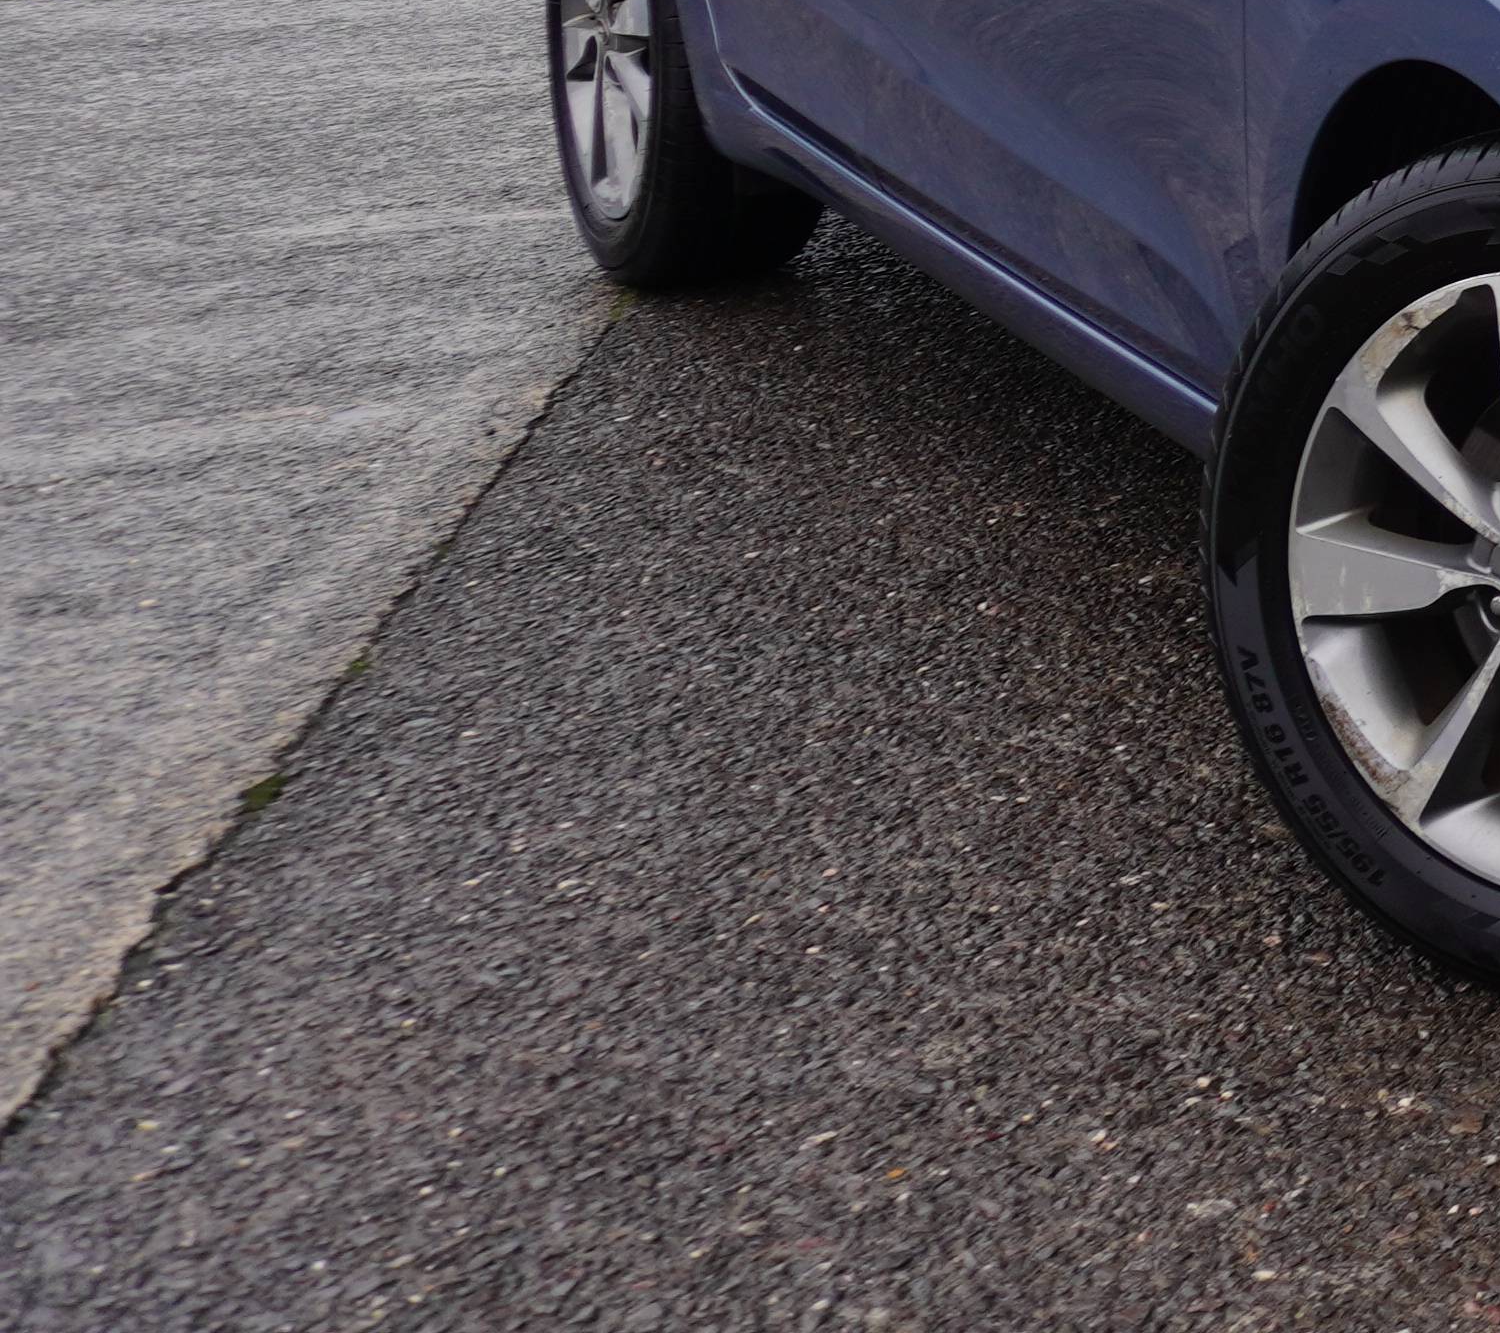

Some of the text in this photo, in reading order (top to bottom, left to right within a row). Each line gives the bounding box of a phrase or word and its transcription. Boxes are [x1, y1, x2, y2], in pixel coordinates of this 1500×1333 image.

[1236, 646, 1386, 889] 195/55 R16 87V
